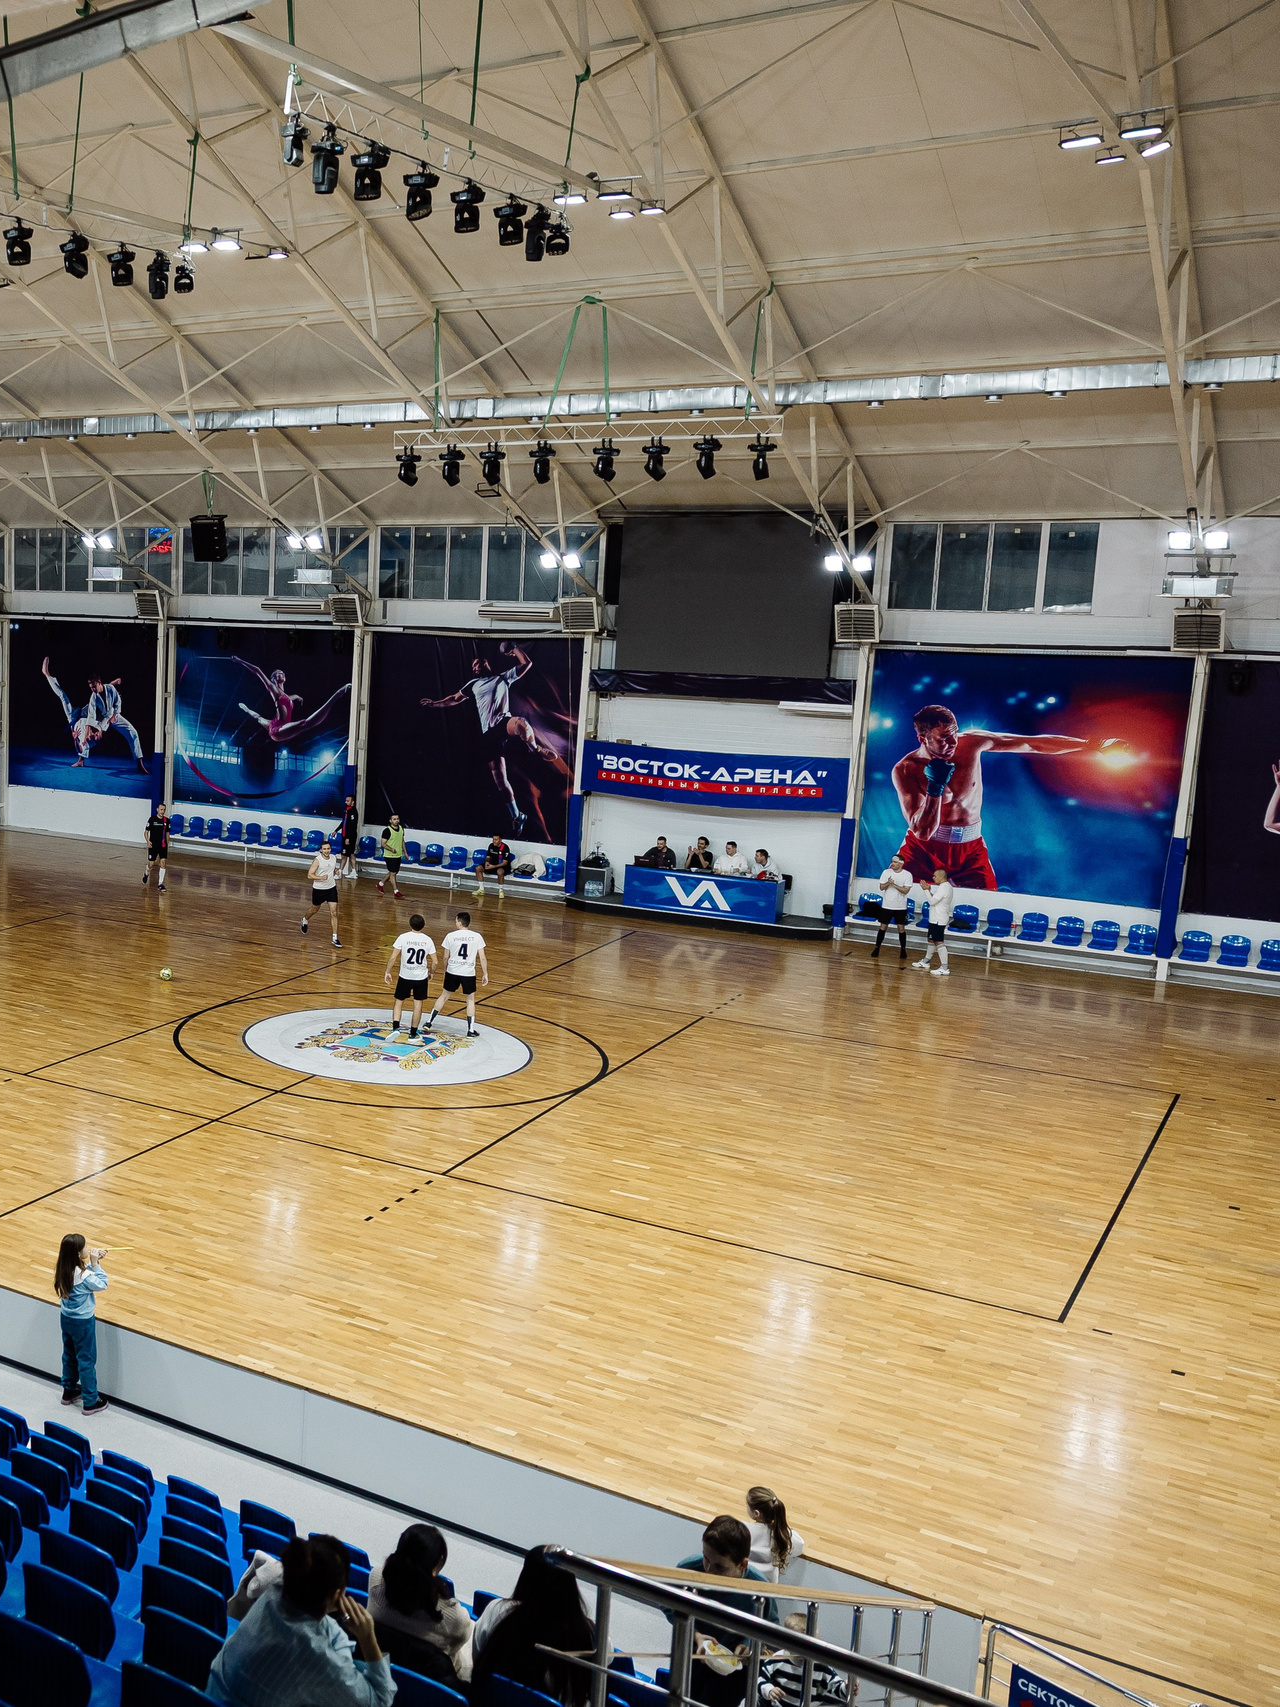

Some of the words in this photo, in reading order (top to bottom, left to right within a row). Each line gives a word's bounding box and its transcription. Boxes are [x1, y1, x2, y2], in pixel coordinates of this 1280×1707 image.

[596, 753, 828, 786] "ВОСТОК-АРЕНА"
[601, 771, 700, 790] СПОРТИВНЫЙ
[721, 784, 818, 797] КОМПЛЕКС
[406, 947, 426, 965] 20
[458, 943, 468, 960] 4
[1017, 1678, 1076, 1707] СЕКТО
